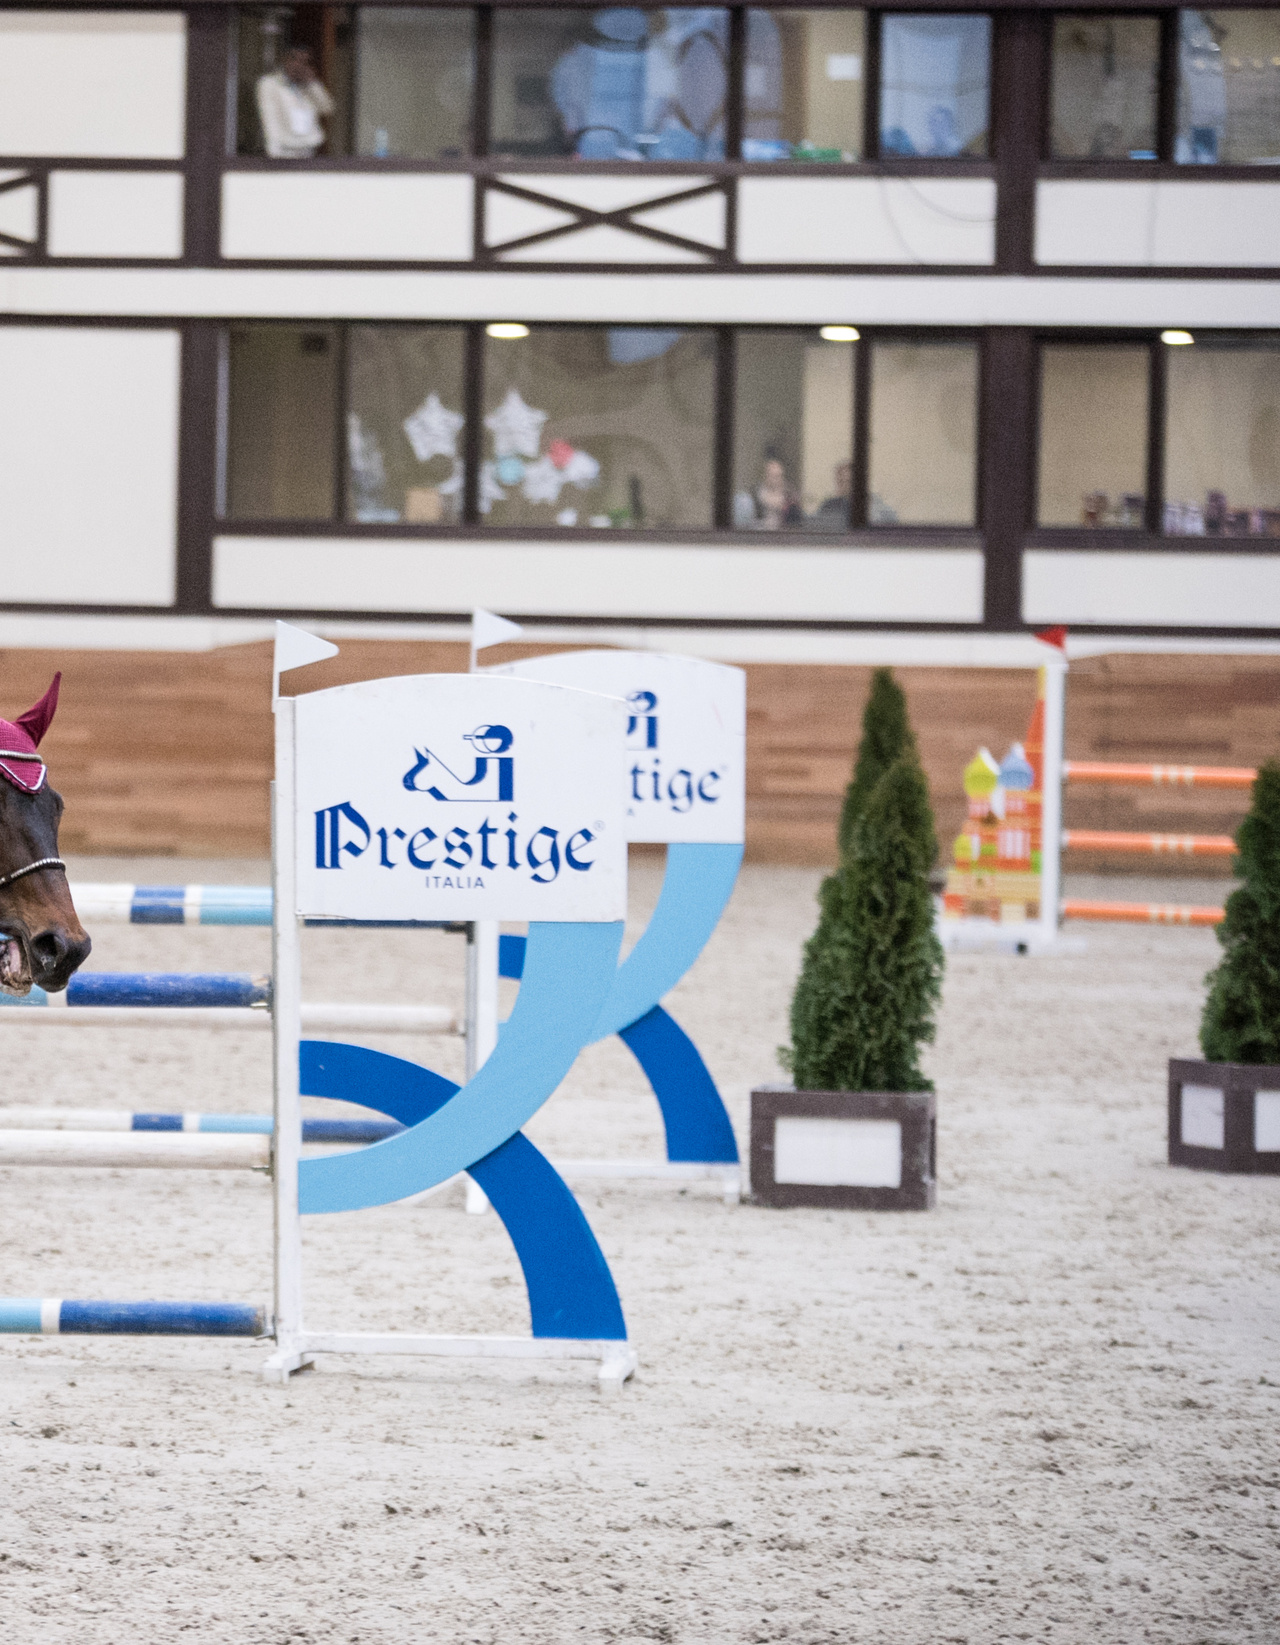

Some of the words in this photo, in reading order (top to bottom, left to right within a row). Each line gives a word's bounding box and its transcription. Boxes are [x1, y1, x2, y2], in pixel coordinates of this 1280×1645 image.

[631, 758, 721, 813] tige
[314, 800, 597, 884] Prestige
[425, 875, 486, 890] ITALIA
